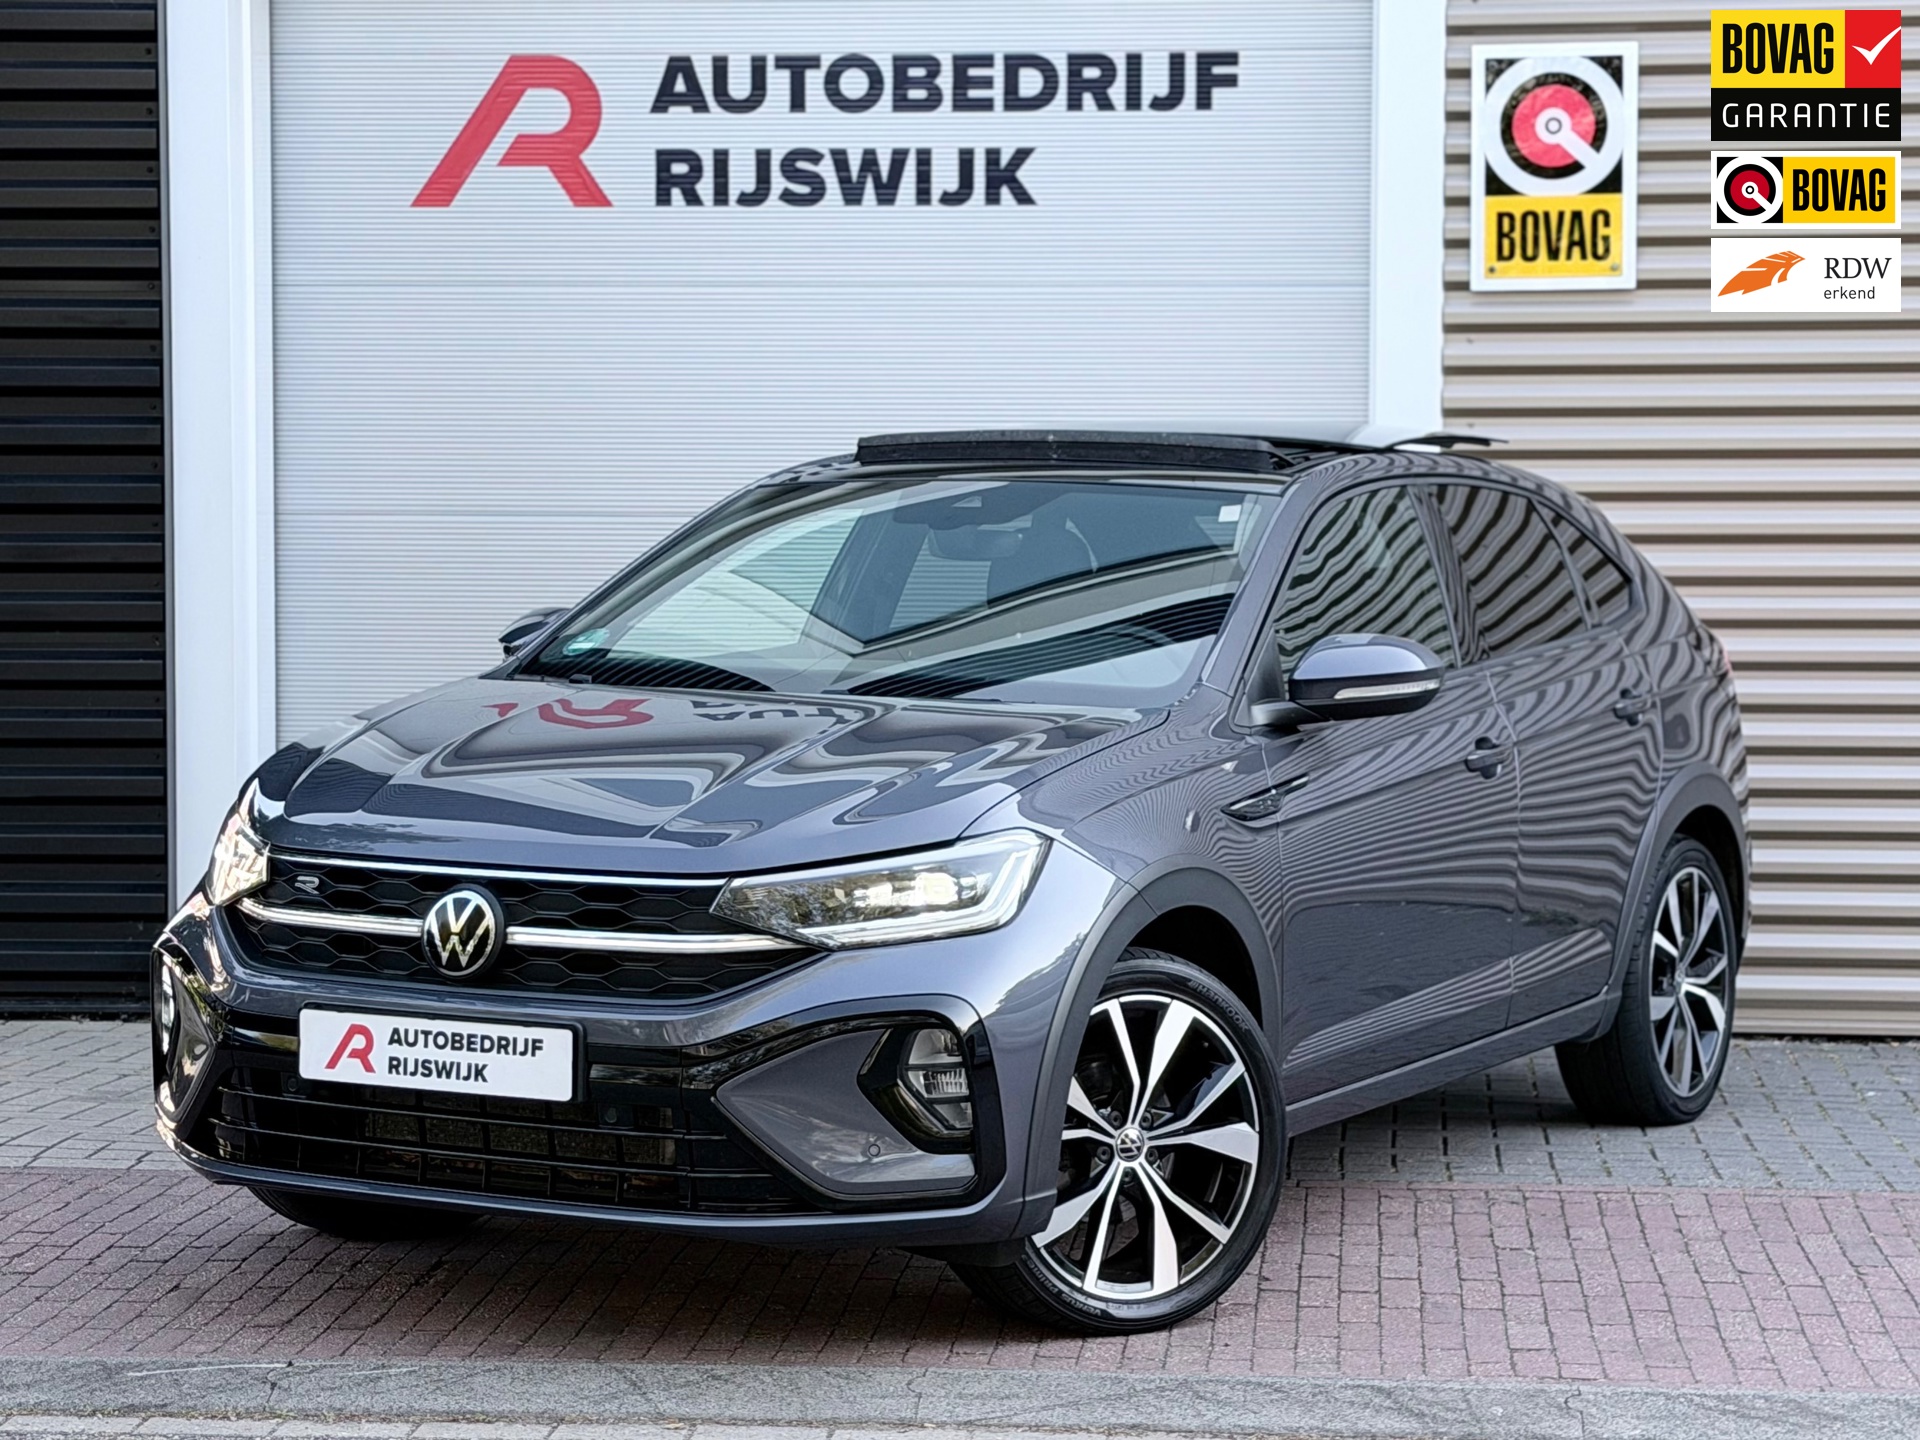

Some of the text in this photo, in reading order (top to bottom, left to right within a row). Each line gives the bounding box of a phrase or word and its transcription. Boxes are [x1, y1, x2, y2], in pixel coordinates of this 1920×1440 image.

[650, 51, 1240, 114] AUTOBEDRIJF
[654, 147, 1037, 207] RIJSWIJK
[1496, 209, 1611, 262] BOVAG
[387, 1027, 544, 1058] AUTOBEDRIJF
[387, 1056, 489, 1083] RIJSWIJK
